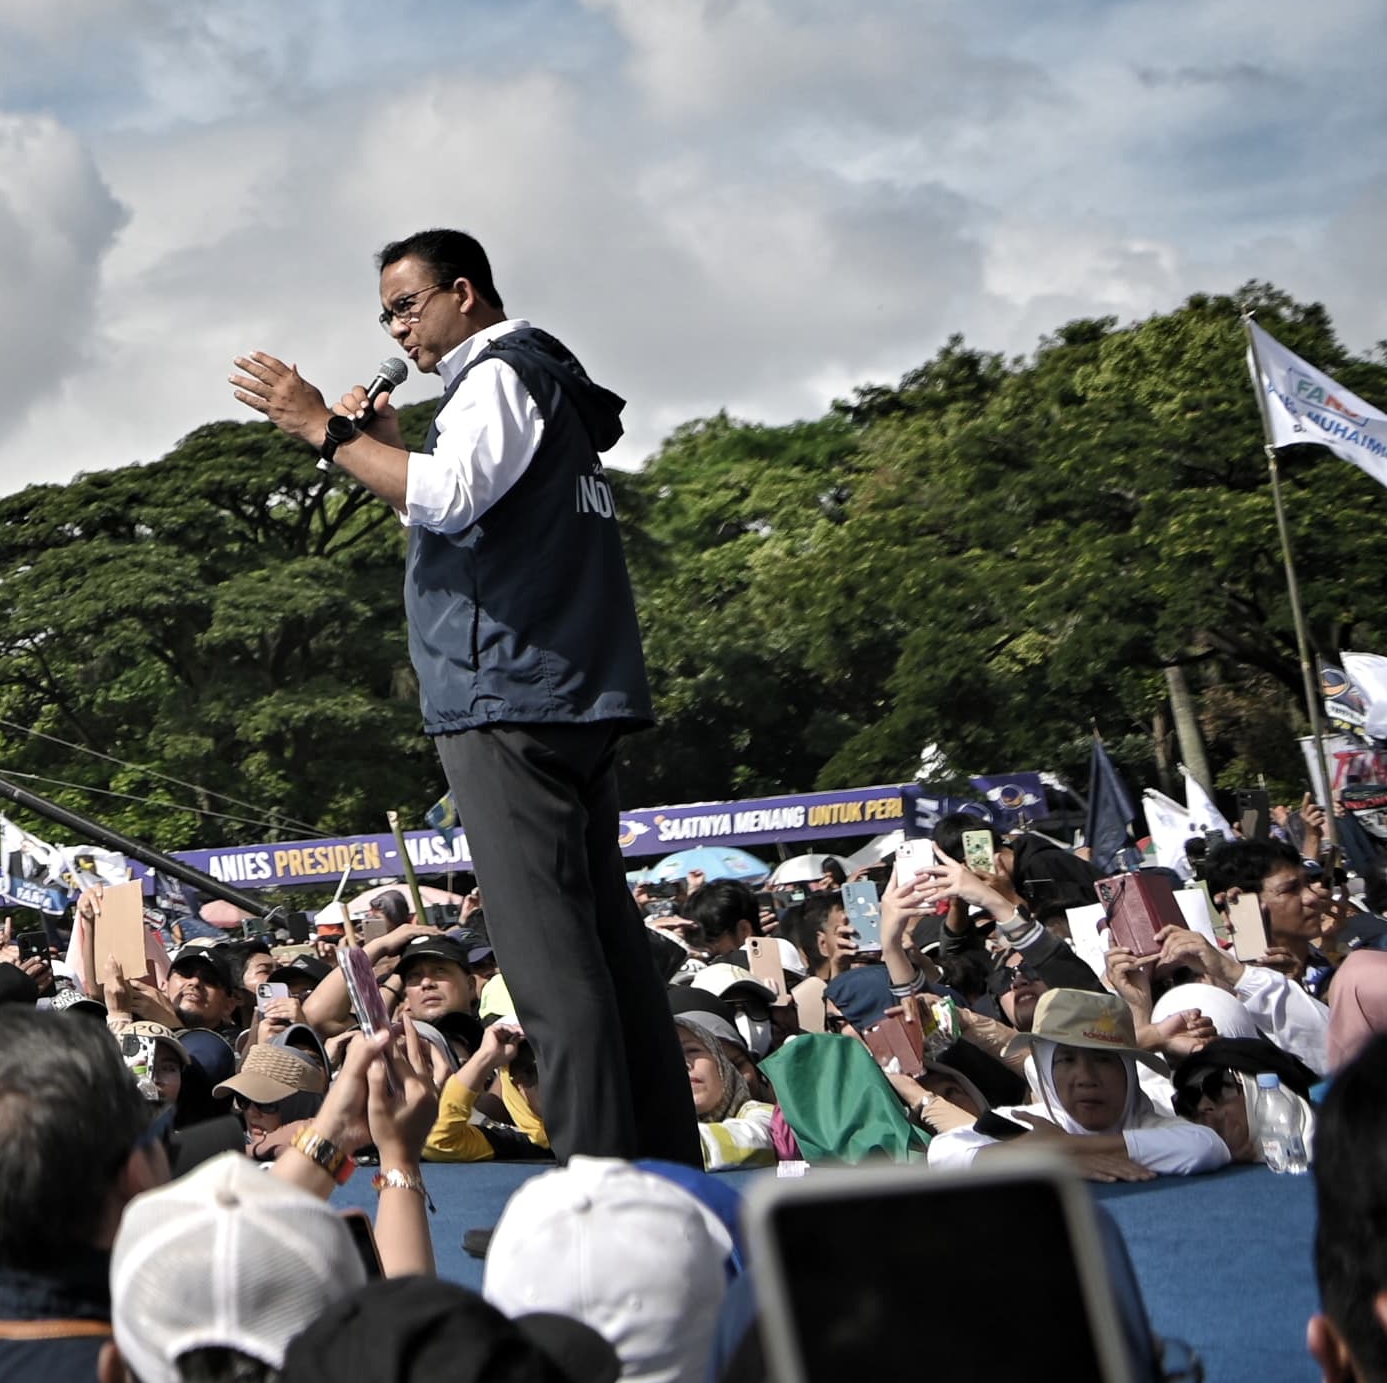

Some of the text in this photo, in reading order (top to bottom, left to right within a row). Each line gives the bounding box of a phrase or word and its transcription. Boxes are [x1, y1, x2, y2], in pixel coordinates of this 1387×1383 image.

[658, 814, 731, 841] SAATNYA
[734, 806, 805, 833] MENANG
[808, 801, 864, 827] UNTUK
[210, 851, 272, 882] ANIES
[274, 842, 382, 877] PRESIDEN
